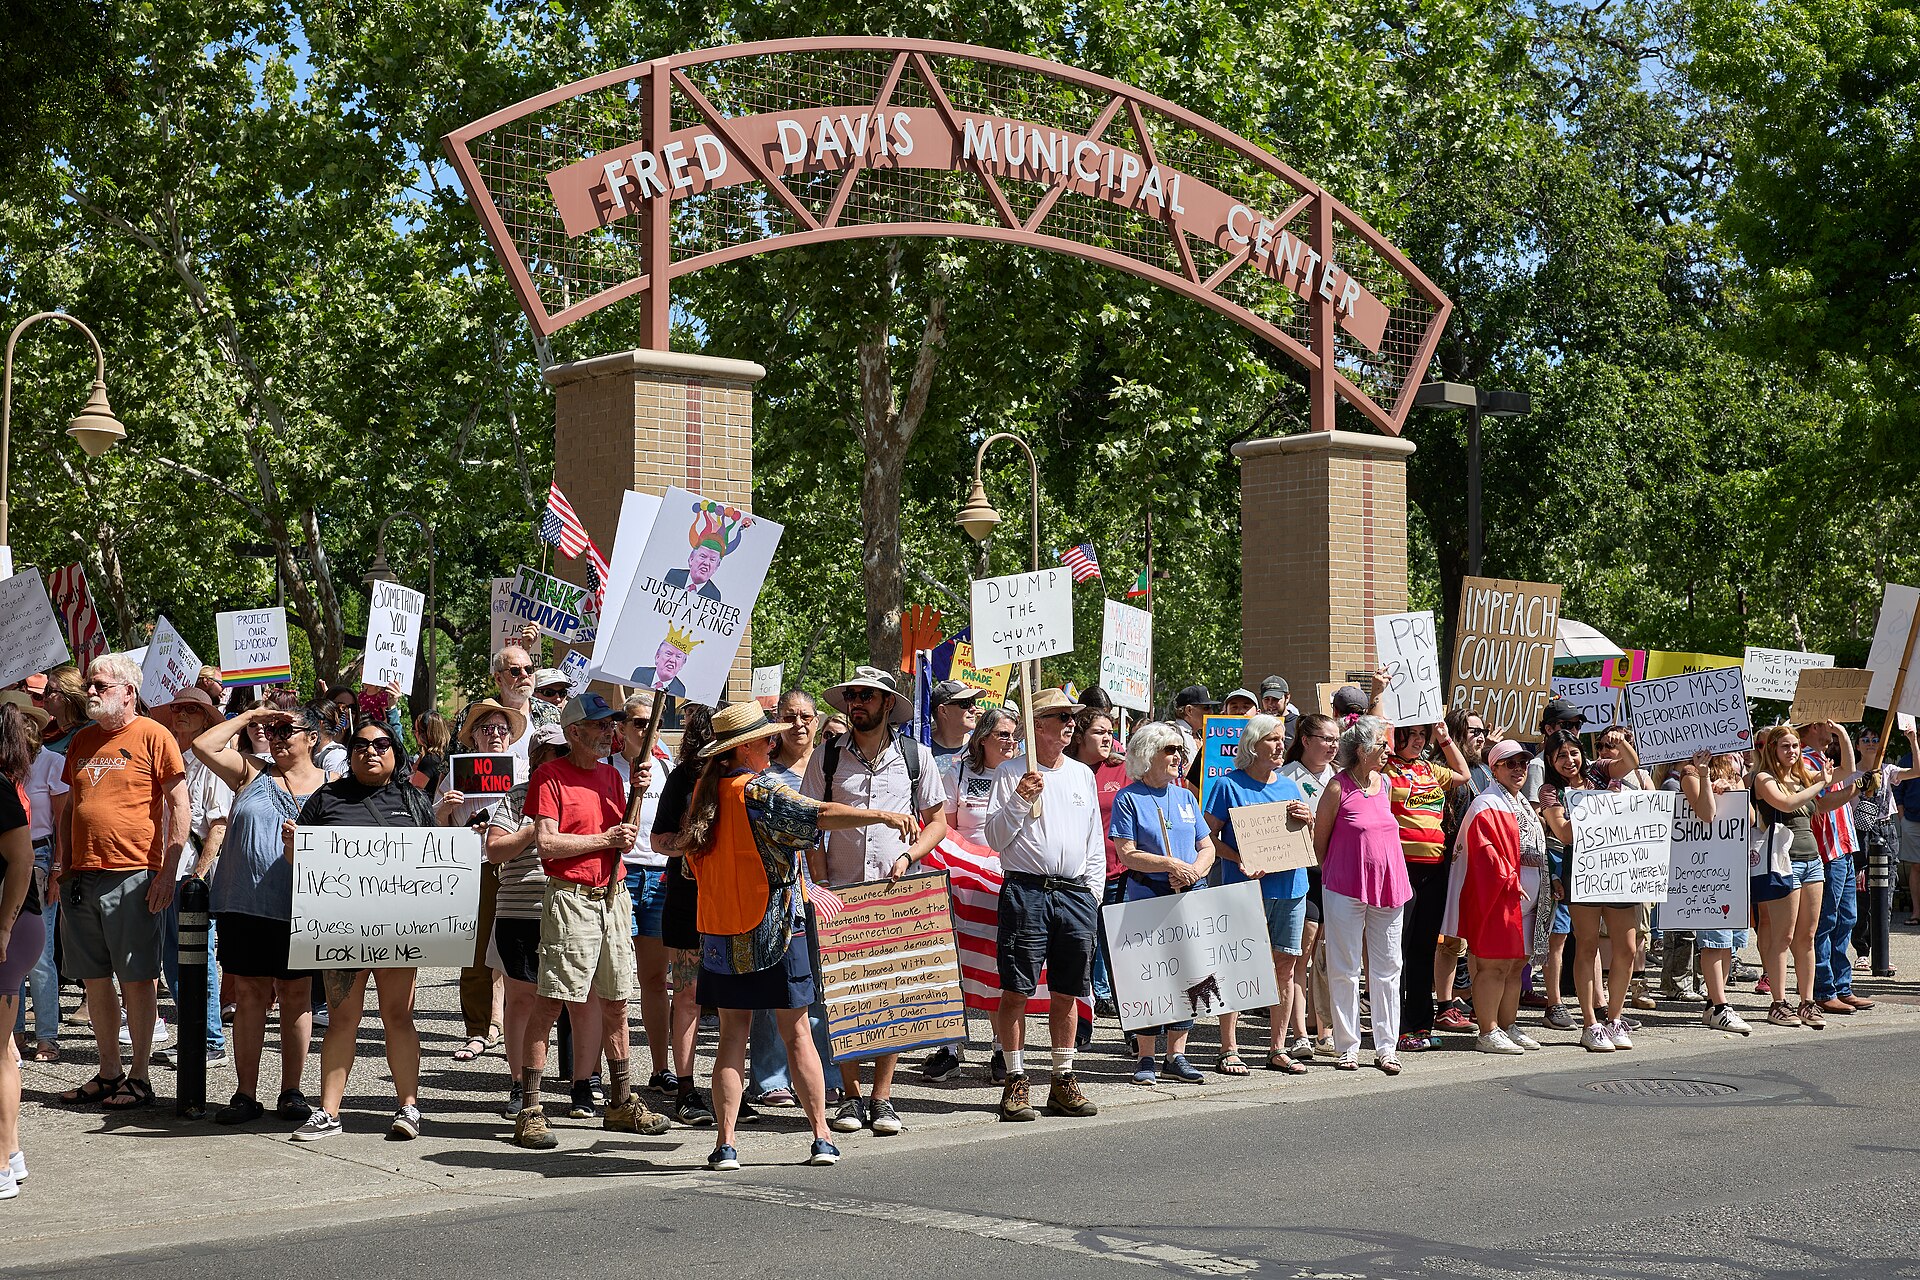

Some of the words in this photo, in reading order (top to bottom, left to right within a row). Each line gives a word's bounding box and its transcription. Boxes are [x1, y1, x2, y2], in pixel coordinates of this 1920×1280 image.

[603, 133, 729, 209] FRED
[776, 111, 914, 165] DAVIS
[963, 118, 1185, 215] MUNICIPAL
[1227, 204, 1361, 319] CENTER
[520, 567, 587, 617] TANK
[987, 571, 1057, 604] DUMP
[373, 583, 421, 615] SOMETHING
[641, 576, 681, 600] JUST
[677, 590, 689, 606] A
[692, 595, 741, 624] JESTER
[236, 613, 272, 626] PROTECT
[509, 591, 580, 635] TRUMP
[653, 597, 681, 618] NOT
[681, 608, 692, 624] A
[697, 612, 735, 637] KING
[1007, 601, 1036, 620] THE
[1464, 585, 1557, 638] IMPEACH
[248, 627, 267, 637] OUR
[390, 610, 407, 633] YOU
[234, 637, 278, 650] DEMOCRACY
[375, 633, 397, 653] Care
[992, 623, 1044, 644] CHUMP
[248, 651, 271, 663] NOW
[960, 645, 972, 656] If
[1003, 638, 1057, 660] TRUMP
[1750, 650, 1782, 664] FREE
[390, 655, 398, 667] is
[560, 661, 577, 676] NOT
[567, 651, 588, 669] I'M
[1457, 634, 1553, 687] CONVICT
[961, 668, 993, 686] PARADE
[1761, 678, 1780, 686] ONE
[1808, 671, 1861, 689] DEFEND
[1631, 681, 1679, 708] STOP
[1688, 670, 1739, 698] MASS
[1634, 698, 1729, 728] DEPORTATIONS
[1731, 693, 1741, 710] &
[1797, 699, 1859, 720] DEMOCRACY
[1208, 727, 1243, 738] JUST
[1639, 717, 1739, 749] KIDNAPPINGS
[1719, 740, 1747, 750] another
[77, 758, 99, 766] GHOST
[100, 757, 127, 766] RANCH
[473, 758, 493, 775] NO
[1570, 792, 1622, 821] SOME
[1629, 794, 1644, 812] OF
[1234, 819, 1246, 829] NO
[1240, 831, 1251, 840] NO
[1255, 825, 1280, 836] KINGS
[1671, 820, 1712, 842] SHOW
[1718, 817, 1745, 842] UP!
[297, 832, 315, 852] I
[324, 831, 413, 866] thought
[422, 831, 467, 865] ALL
[1257, 843, 1291, 853] IMPEACH
[1574, 823, 1668, 854] ASSIMILATED
[1577, 855, 1595, 873] SO
[1631, 847, 1649, 864] YOU
[1574, 871, 1627, 895] FORGOT
[1628, 865, 1659, 880] WHERE
[1675, 866, 1731, 881] Democracy
[921, 881, 932, 890] is
[1630, 881, 1655, 894] CAME
[1691, 883, 1732, 896] everyone
[1685, 895, 1698, 906] of
[1702, 895, 1717, 904] us
[873, 911, 886, 921] to
[926, 903, 946, 913] the
[1677, 907, 1702, 919] right
[290, 916, 303, 935] I
[307, 918, 355, 939] guess
[361, 923, 392, 937] NOT
[441, 915, 477, 940] They
[830, 925, 903, 945] Insurrection
[913, 920, 939, 932] Act.
[1121, 914, 1230, 951] DEMOCRACY
[821, 953, 831, 965] A
[903, 936, 945, 951] demands
[1206, 938, 1255, 966] SAVE
[822, 972, 836, 985] to
[842, 968, 857, 981] be
[862, 962, 894, 978] honored
[1140, 957, 1180, 981] OUR
[848, 980, 888, 996] Military
[1236, 976, 1260, 999] NO
[828, 1005, 839, 1018] A
[879, 998, 890, 1007] is
[899, 990, 949, 1004] demanding
[1121, 993, 1174, 1018] KINGS
[857, 1012, 882, 1028] Law
[831, 1034, 853, 1052] THE
[887, 1023, 909, 1039] IS
[910, 1019, 933, 1034] NOT
